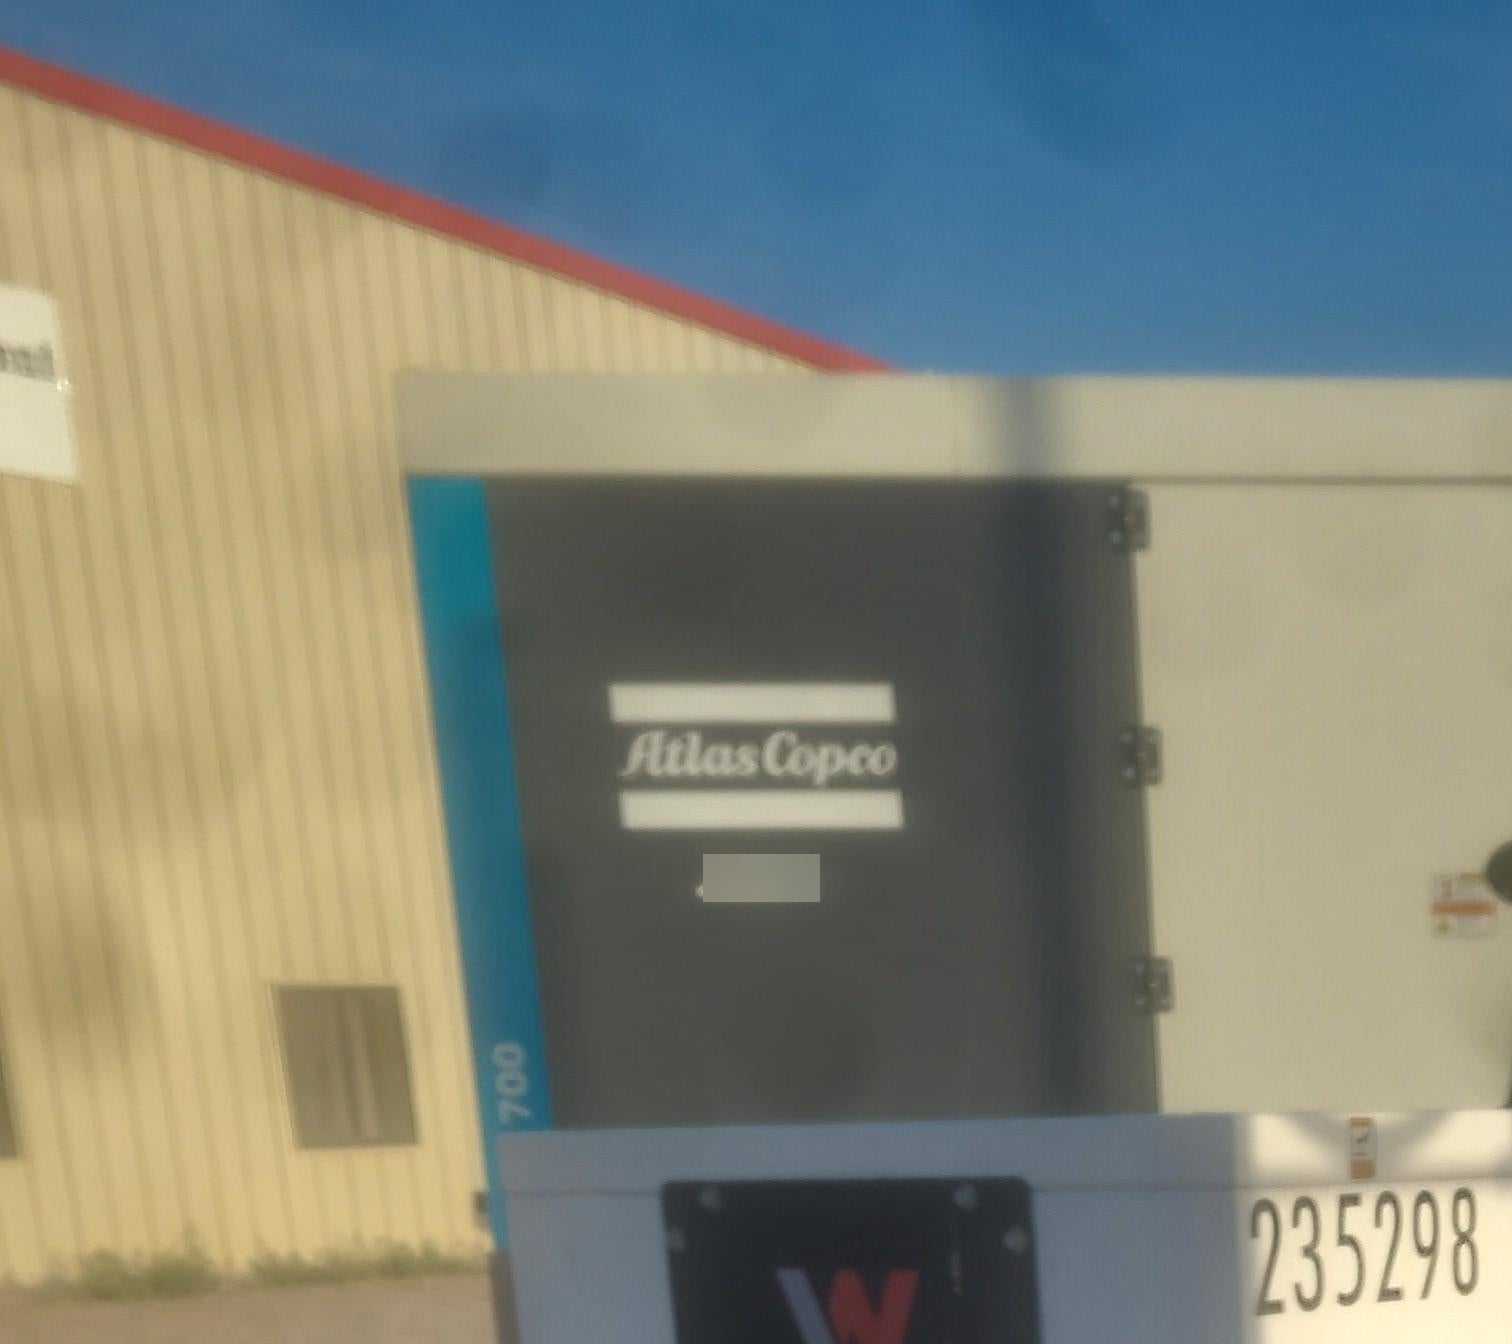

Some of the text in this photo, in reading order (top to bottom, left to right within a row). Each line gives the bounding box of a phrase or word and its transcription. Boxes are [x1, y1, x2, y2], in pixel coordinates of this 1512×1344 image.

[617, 729, 898, 787] Atlas Copco
[492, 1042, 531, 1123] 700
[1250, 1187, 1480, 1316] 235298
